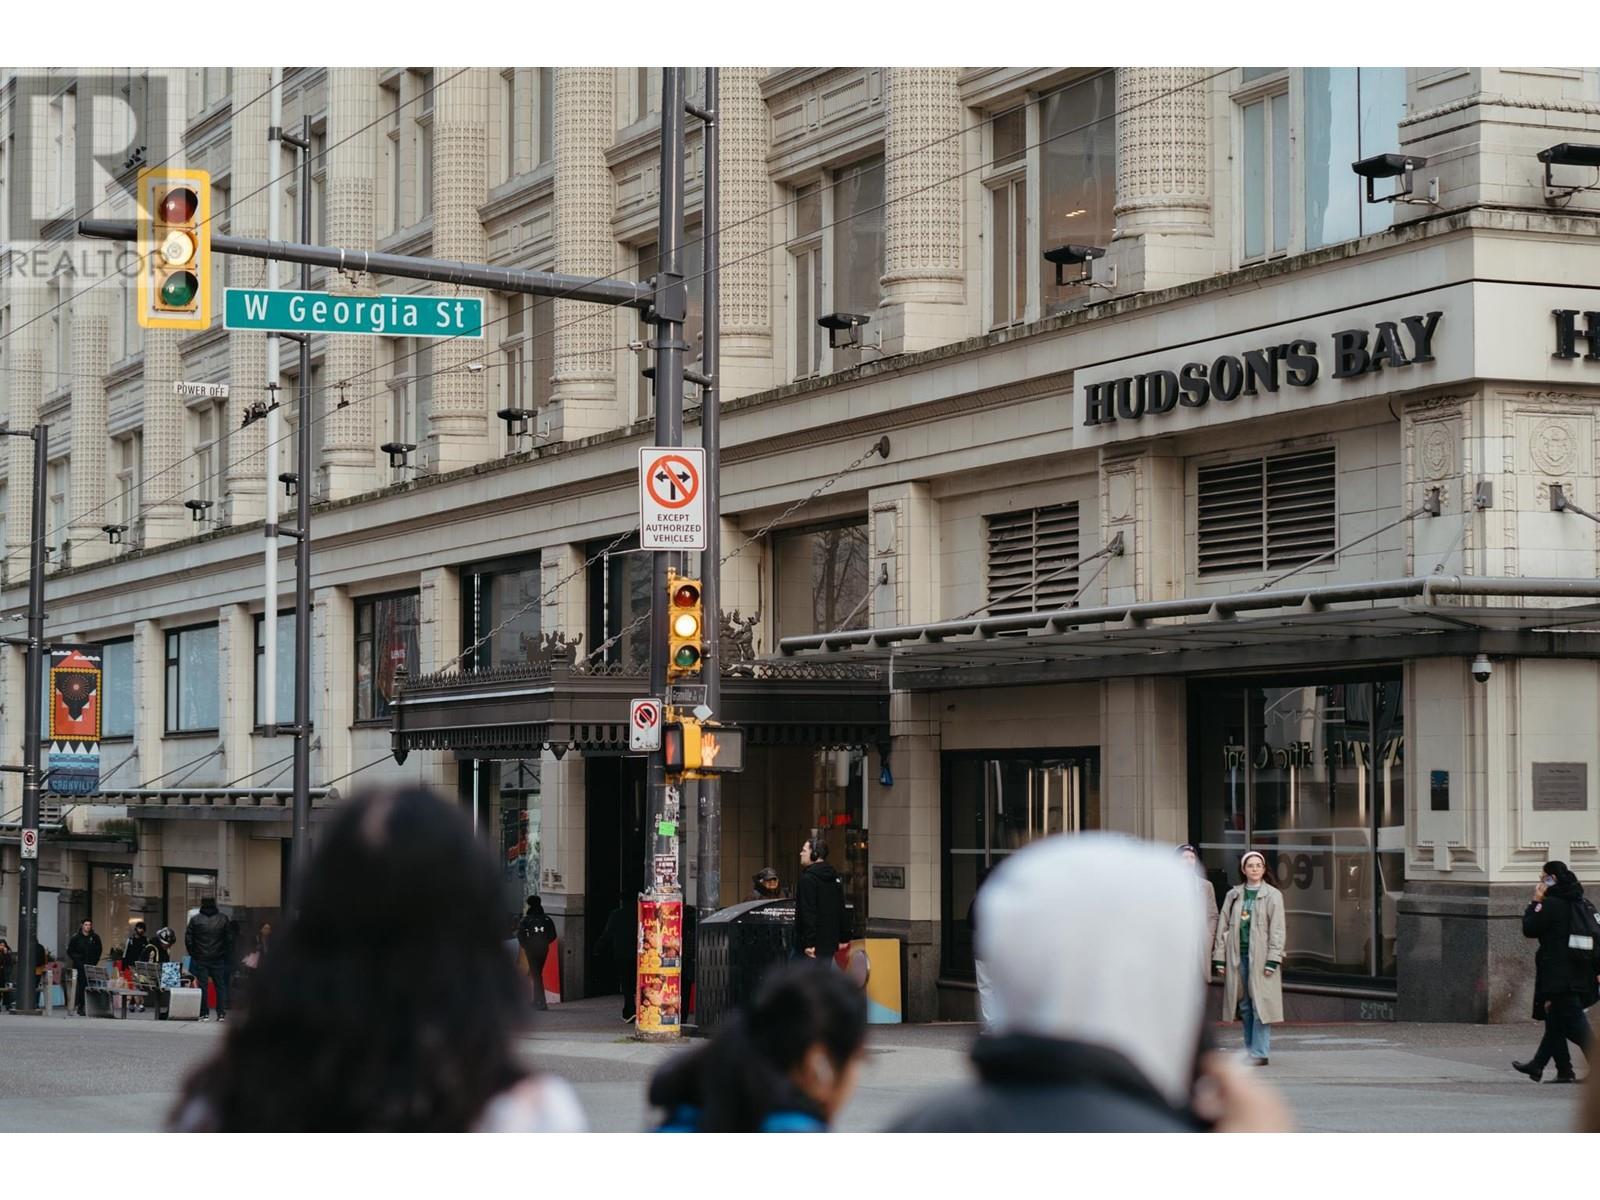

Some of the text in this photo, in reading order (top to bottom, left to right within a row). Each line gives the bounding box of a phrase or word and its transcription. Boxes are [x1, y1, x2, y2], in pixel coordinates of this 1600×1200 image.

[244, 294, 464, 332] W Georgia St
[1083, 311, 1443, 426] HUDSON'S BAY
[177, 384, 225, 397] POWER OFF
[657, 513, 690, 522] EXCEPT
[645, 524, 702, 533] AUTHORIZED
[653, 534, 695, 543] VEHICLES
